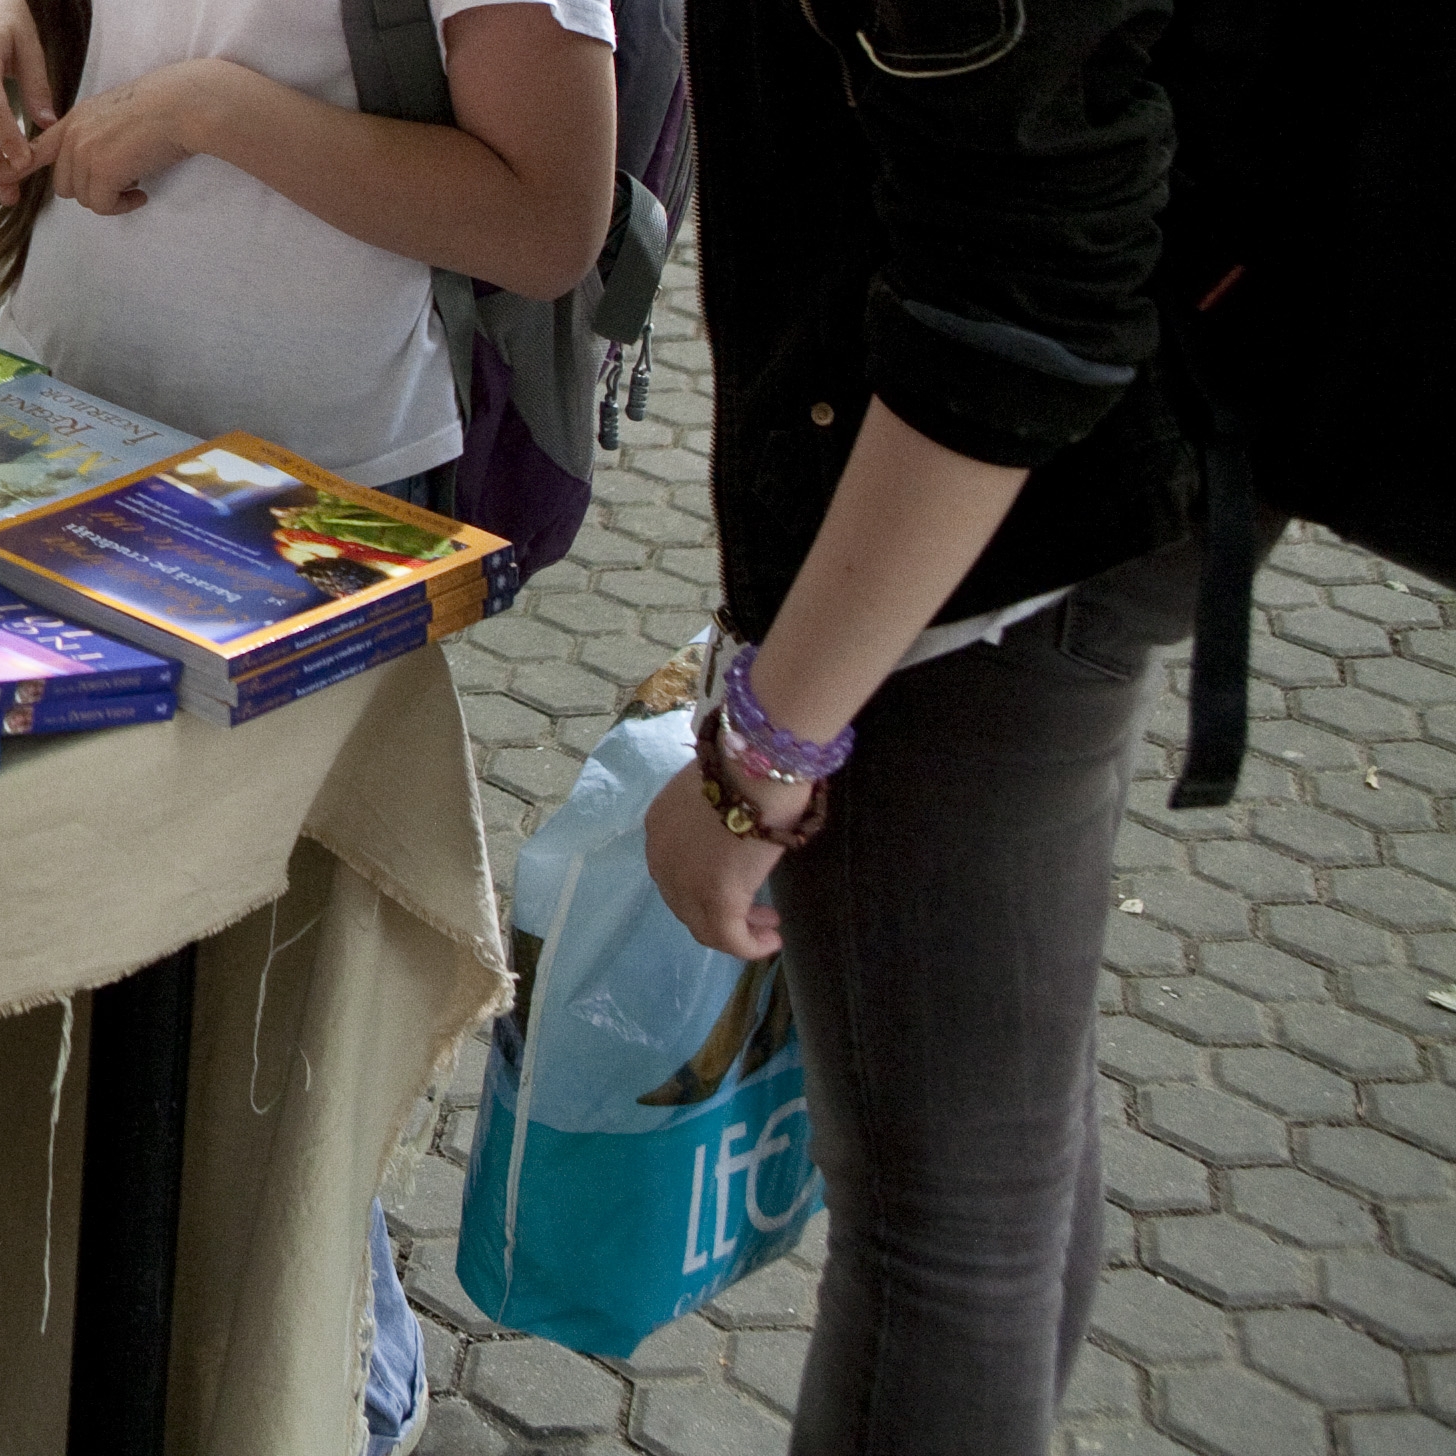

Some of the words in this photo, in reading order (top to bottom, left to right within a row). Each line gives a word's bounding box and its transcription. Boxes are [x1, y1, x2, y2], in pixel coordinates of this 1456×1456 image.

[17, 386, 164, 446] ÎNGERILOR
[56, 520, 157, 564] crudităţi
[169, 570, 244, 603] bazată
